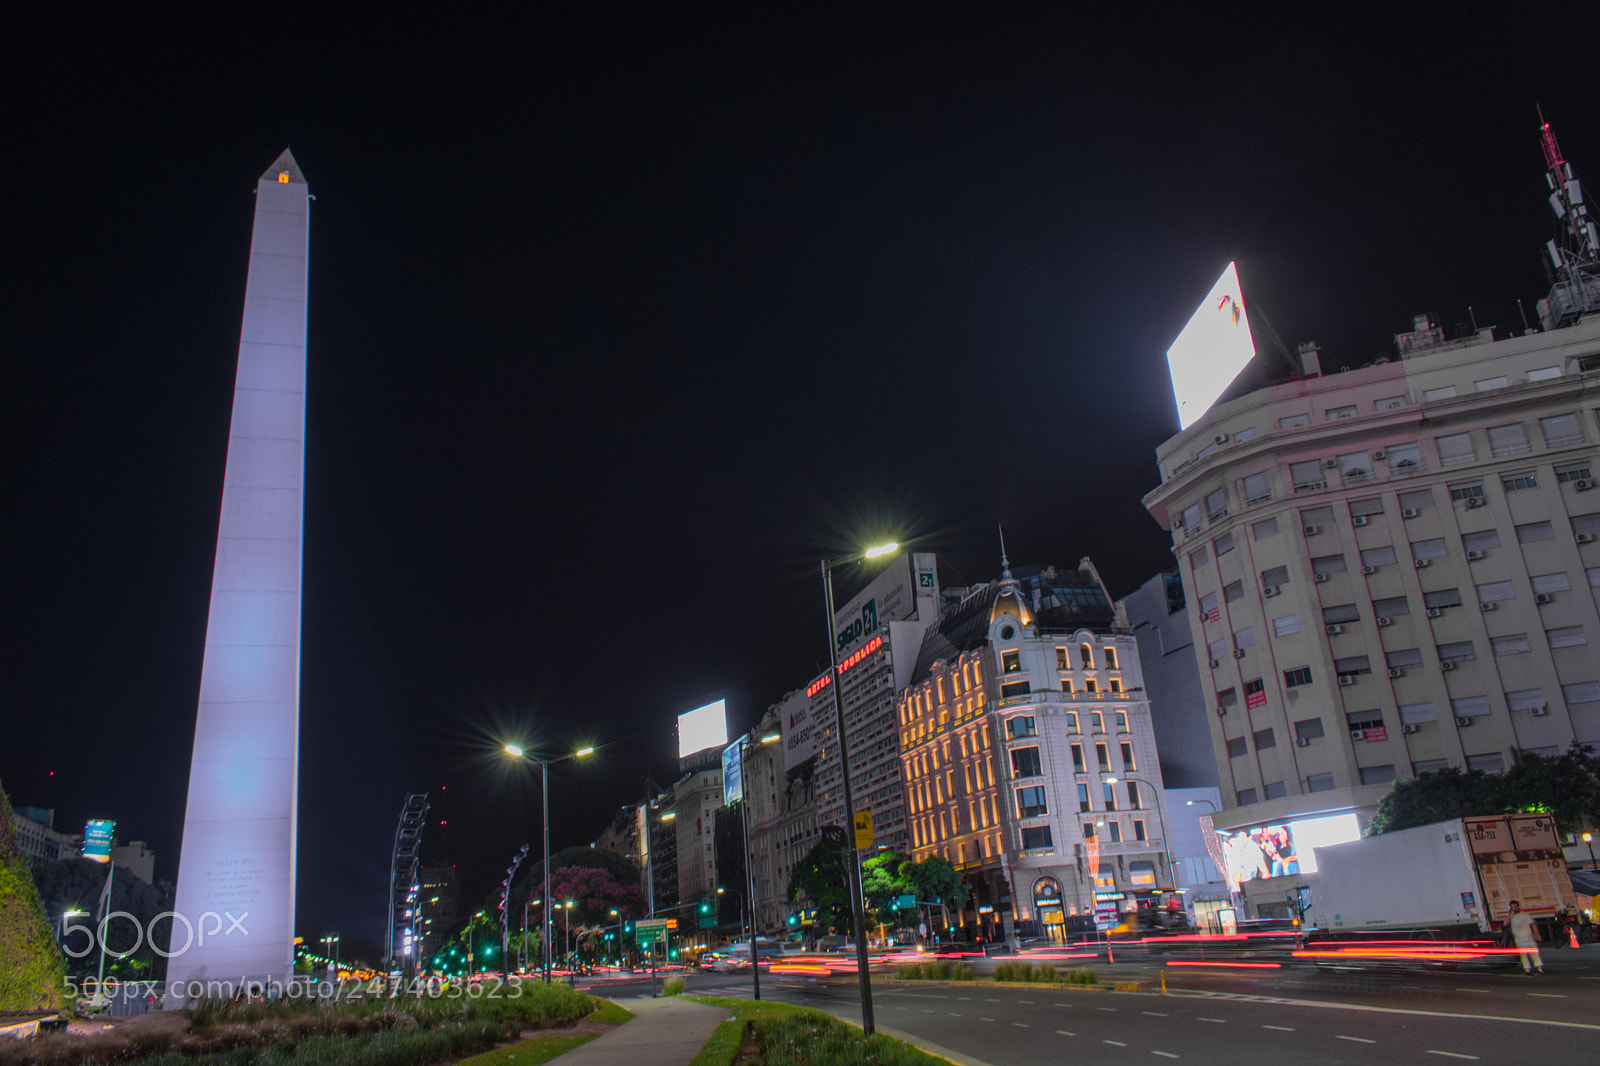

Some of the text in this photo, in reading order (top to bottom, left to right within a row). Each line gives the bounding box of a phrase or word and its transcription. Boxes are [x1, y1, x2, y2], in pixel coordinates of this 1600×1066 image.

[921, 575, 932, 588] 21
[837, 608, 875, 652] SIGLO 21
[807, 636, 883, 698] HOTEL EPUBLICA
